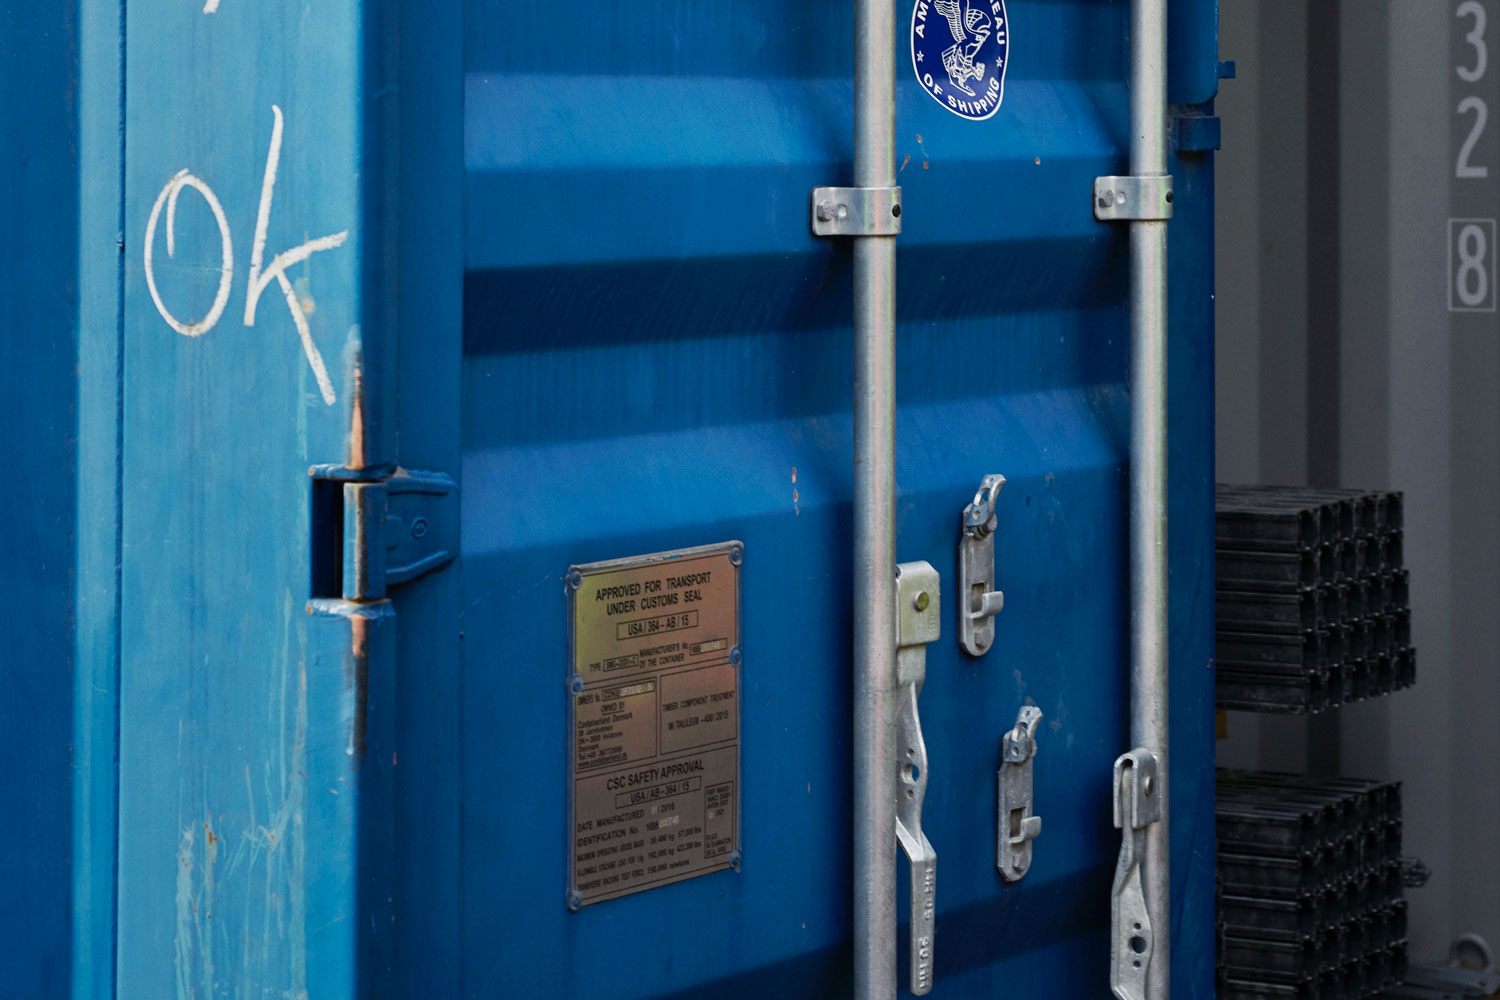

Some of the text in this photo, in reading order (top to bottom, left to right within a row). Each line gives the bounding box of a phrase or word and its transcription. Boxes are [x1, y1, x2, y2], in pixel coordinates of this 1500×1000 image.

[922, 72, 1001, 116] OF SHIPPING
[1457, 224, 1489, 307] 8
[595, 571, 711, 602] APPROVED FOR TRANSPORT
[606, 589, 703, 616] UNDER CUSTOMS SEAL
[606, 759, 704, 791] CSC SAFETY APPROVAL
[577, 820, 593, 832] DATE
[596, 809, 645, 828] MANUFACTURED
[577, 828, 626, 848] IDENTIFICATION
